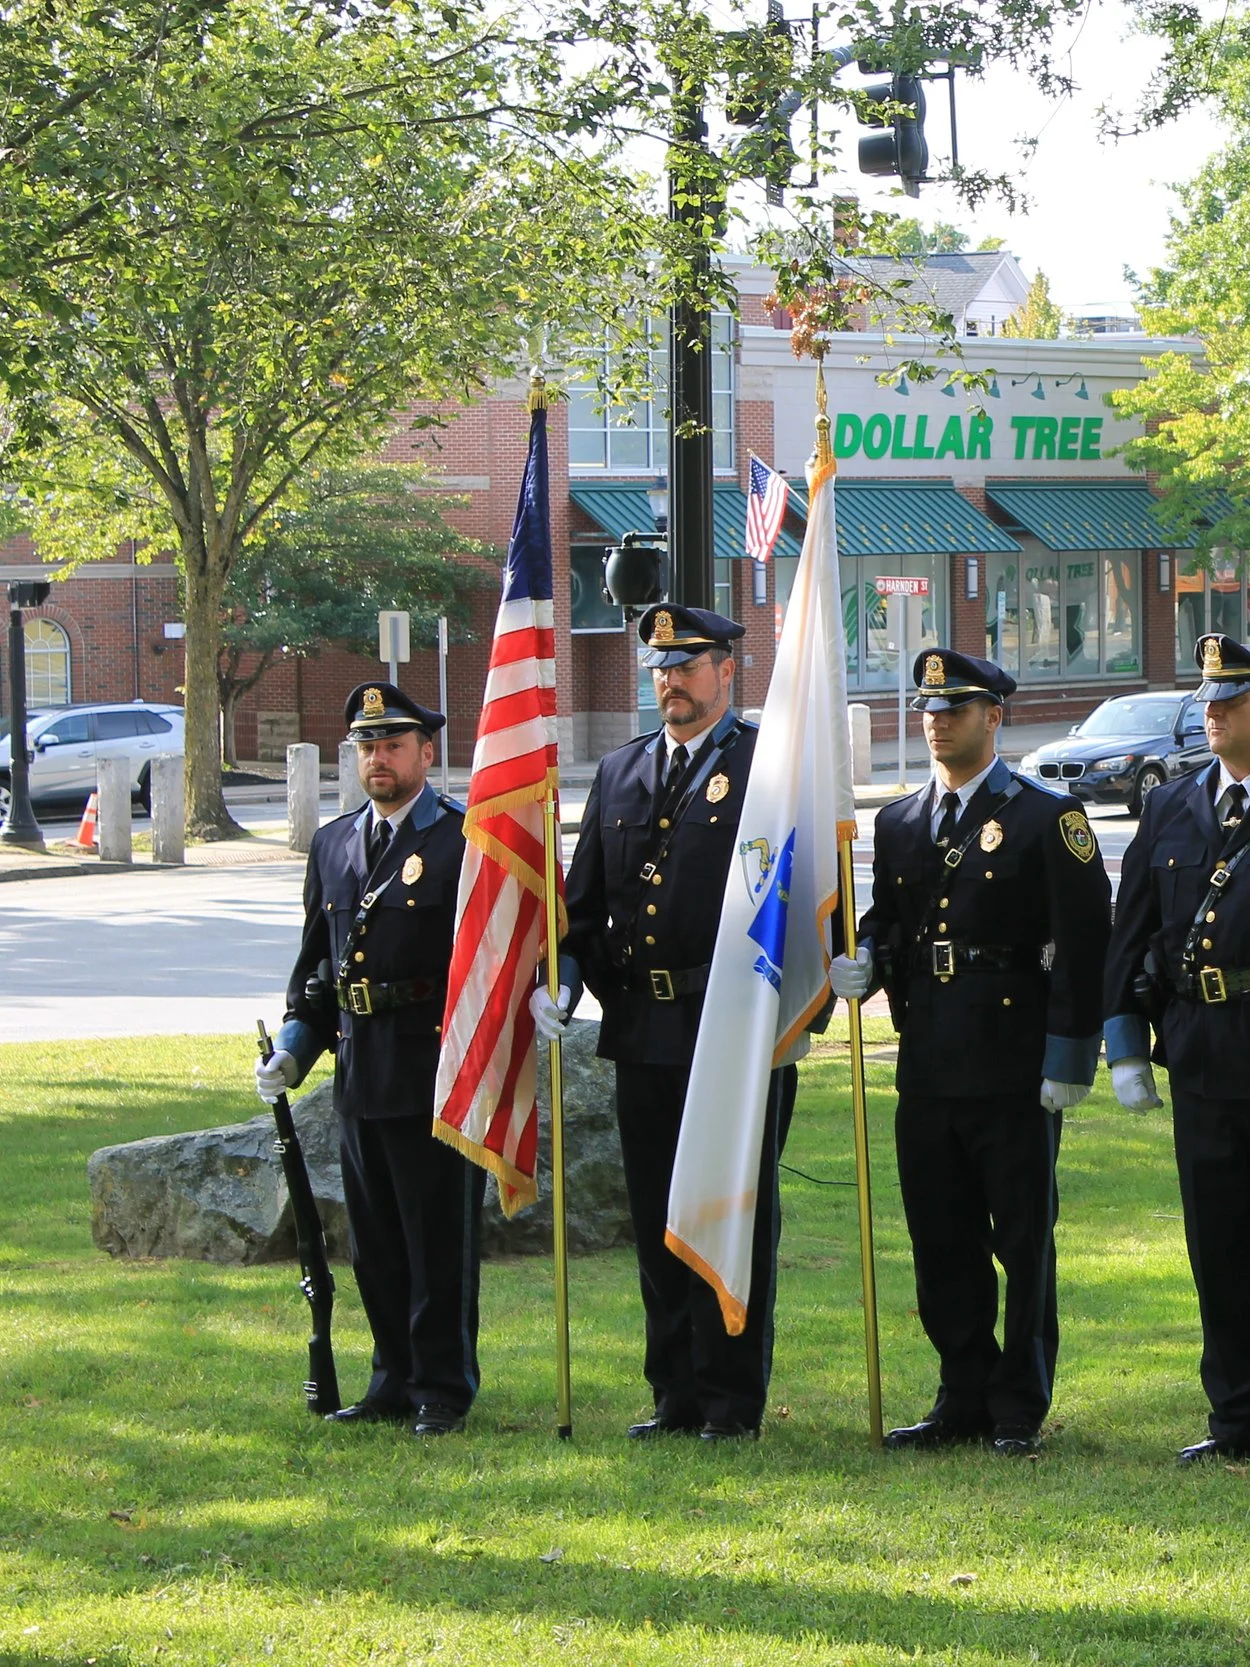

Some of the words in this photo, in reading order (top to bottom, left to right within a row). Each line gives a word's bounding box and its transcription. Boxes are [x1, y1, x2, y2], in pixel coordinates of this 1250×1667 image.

[833, 413, 994, 460] DOLLAR
[1010, 416, 1103, 460] TREE
[1067, 561, 1095, 580] TREE
[885, 579, 919, 593] HARNDEN
[920, 580, 928, 591] ST
